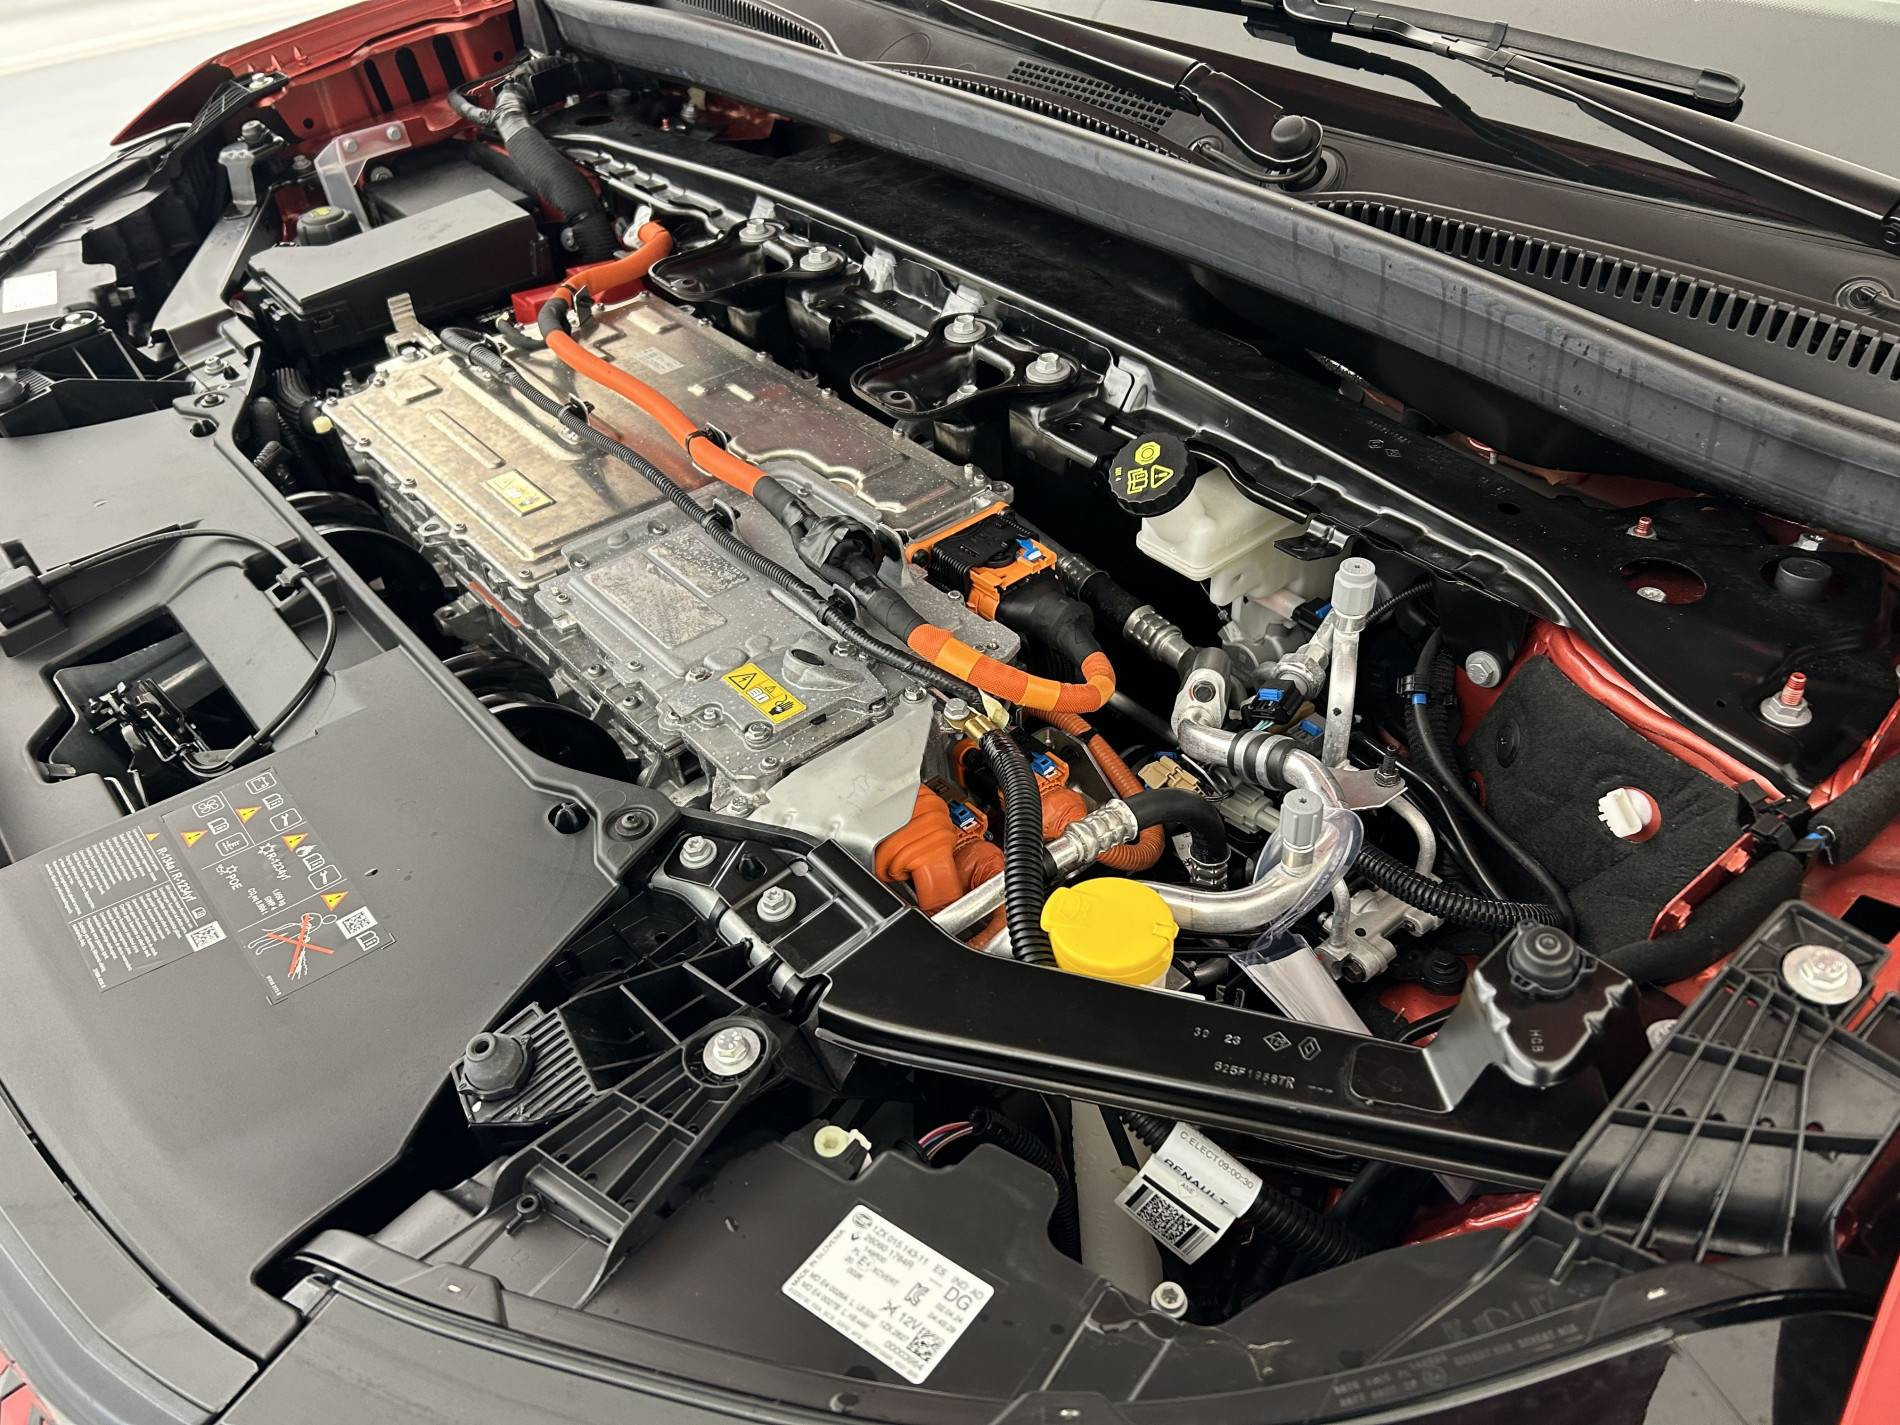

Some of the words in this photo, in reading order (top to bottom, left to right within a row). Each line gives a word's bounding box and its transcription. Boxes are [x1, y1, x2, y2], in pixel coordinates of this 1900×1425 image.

[155, 846, 177, 870] R-134a
[170, 870, 197, 903] R-1234yf
[267, 850, 291, 882] R-1234yf
[225, 872, 243, 891] POE
[1223, 1032, 1242, 1046] 23
[1163, 1157, 1229, 1206] RENAULT
[942, 1284, 974, 1312] DG
[897, 1310, 923, 1331] 12V
